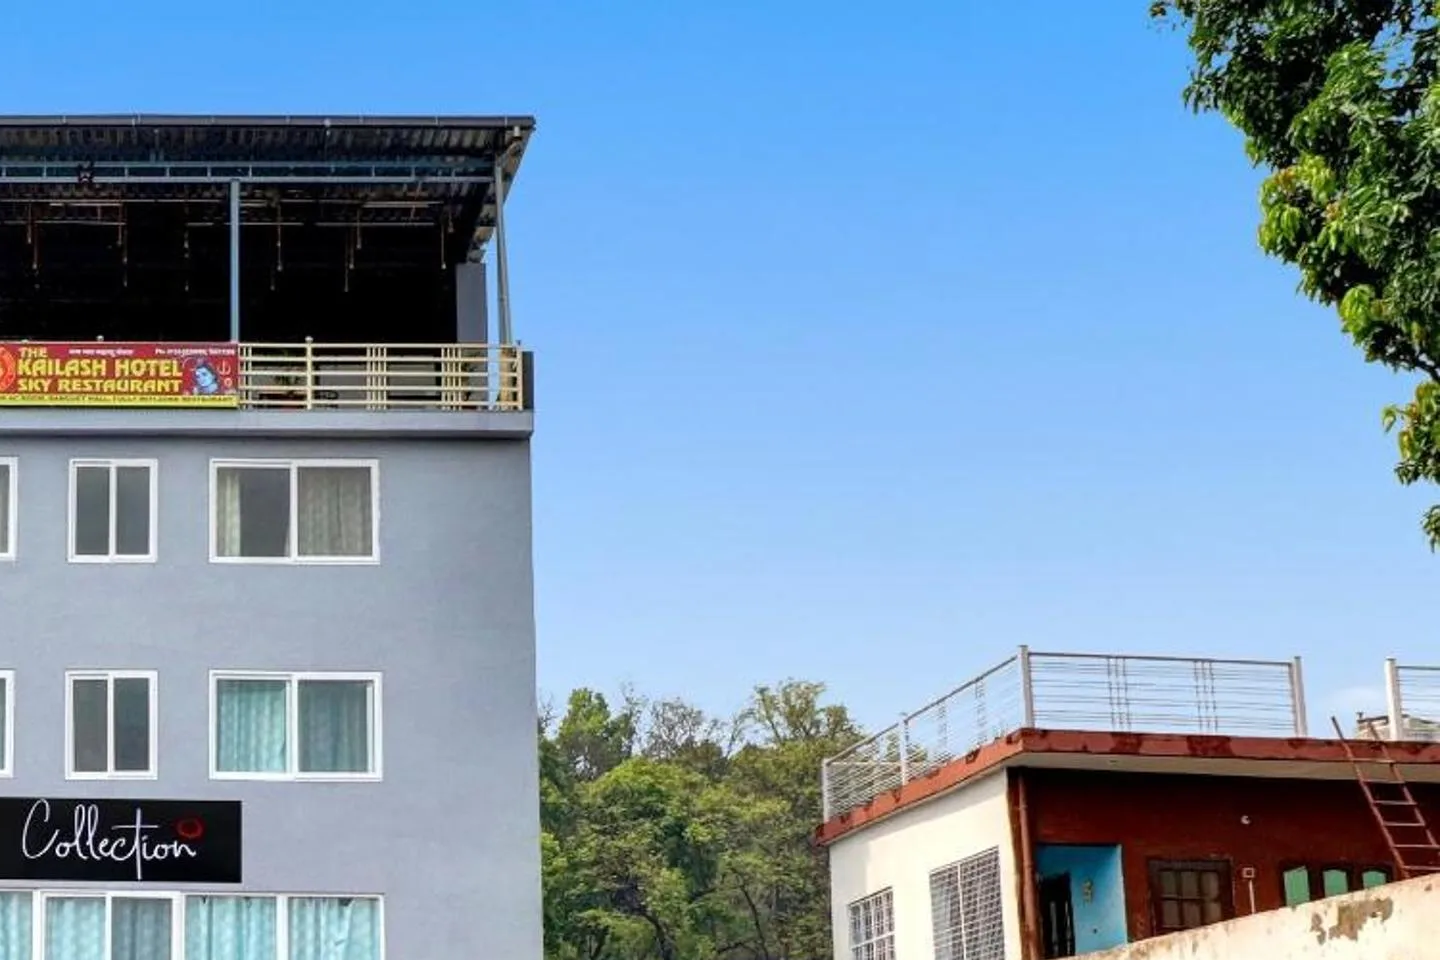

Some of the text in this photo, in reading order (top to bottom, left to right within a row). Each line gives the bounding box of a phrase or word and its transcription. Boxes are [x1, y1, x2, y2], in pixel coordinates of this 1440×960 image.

[18, 346, 48, 358] THE
[17, 358, 107, 378] KAILASH
[114, 358, 184, 378] HOTEL
[17, 378, 183, 393] SKY RESTAURANT
[22, 798, 197, 881] Collection
